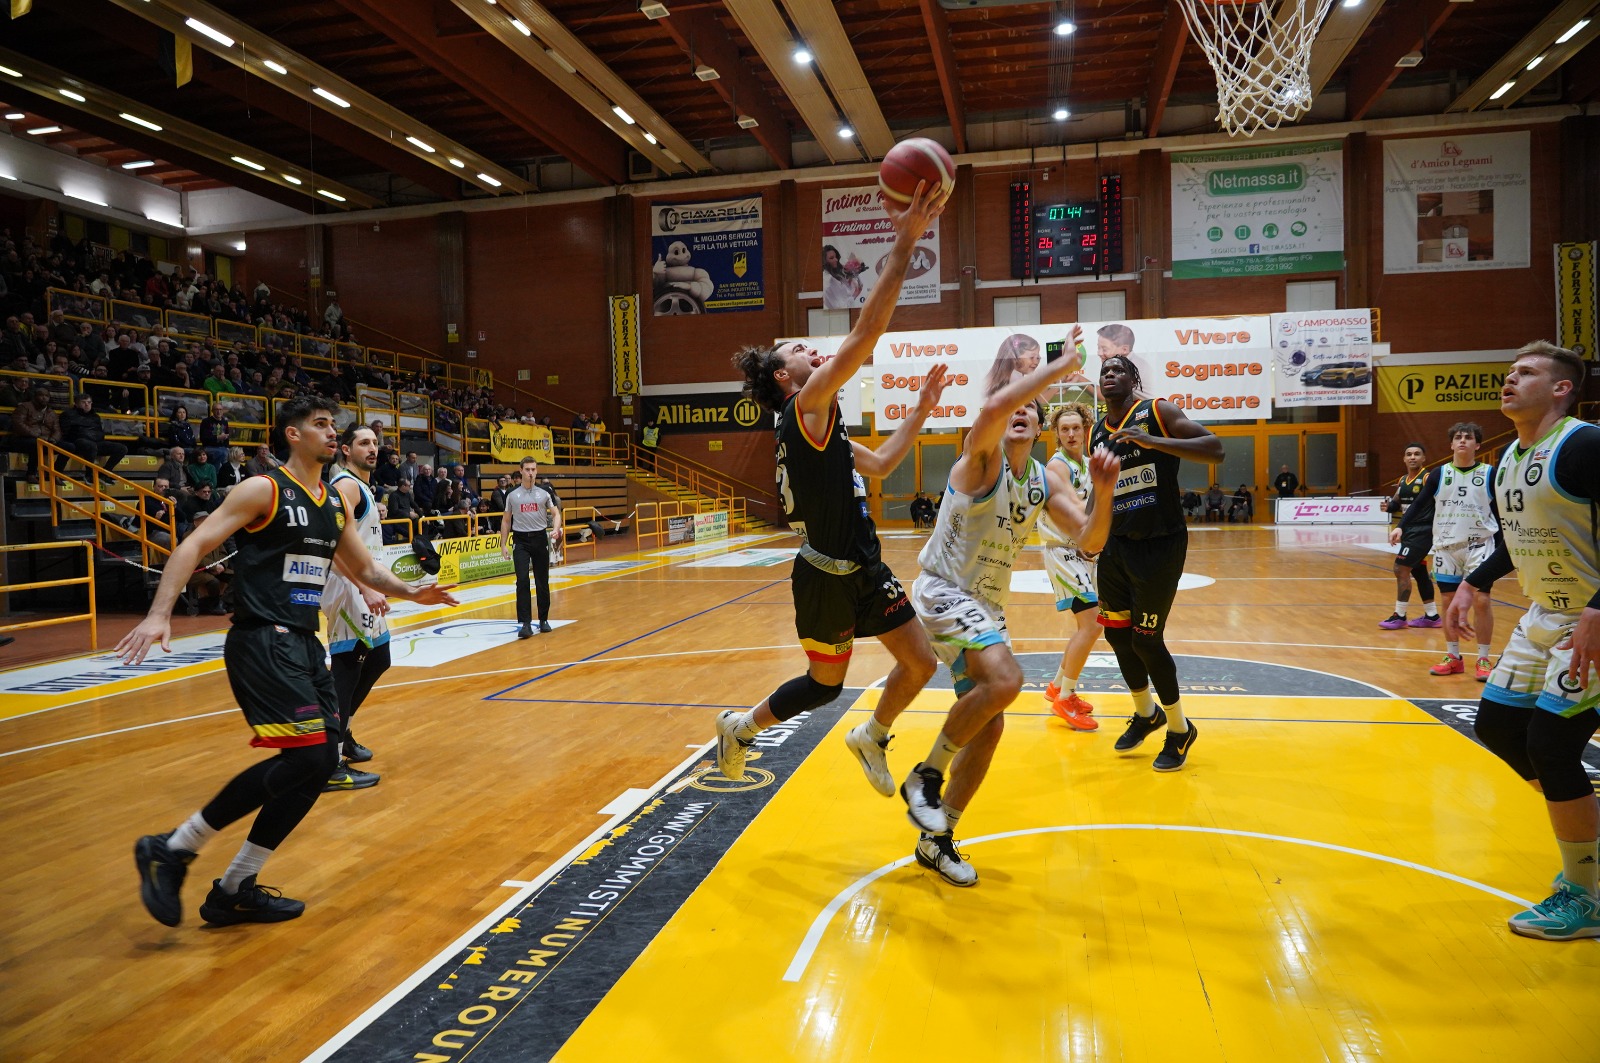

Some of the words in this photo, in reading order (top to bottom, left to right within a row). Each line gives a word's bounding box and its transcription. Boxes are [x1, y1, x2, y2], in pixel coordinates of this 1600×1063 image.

[1192, 155, 1231, 163] PARTNER
[1252, 152, 1277, 160] TUTTE
[1292, 144, 1335, 155] RISPOSTE
[1411, 158, 1450, 169] d'Amico
[1452, 155, 1493, 168] Legnami
[1213, 170, 1298, 189] Netmassa.it
[825, 193, 871, 214] Intimo
[1198, 201, 1243, 212] Esperienza
[681, 206, 759, 219] CIAVARELLA
[1206, 213, 1220, 222] per
[1224, 210, 1231, 218] la
[1234, 208, 1262, 218] vostra
[1265, 207, 1307, 218] tecnologia
[832, 221, 872, 233] L'intimo
[874, 220, 891, 230] che
[701, 234, 728, 242] MIGLIOR
[728, 232, 757, 240] SERVIZIO
[729, 240, 758, 248] VETTURA
[1038, 237, 1053, 249] 26
[1082, 234, 1097, 247] 22
[1048, 256, 1053, 268] 1
[1092, 253, 1096, 265] 1
[1572, 262, 1581, 304] FORZA
[1297, 317, 1367, 327] CAMPOBASSO
[1572, 309, 1581, 342] NERI
[622, 312, 630, 347] FORZA
[1175, 328, 1251, 346] Vivere
[890, 342, 958, 358] Vivere
[1165, 360, 1262, 381] Sognare
[1169, 392, 1260, 410] Giocare
[656, 404, 729, 424] Allianz
[1458, 486, 1467, 497] 5
[1505, 489, 1523, 513] 13
[1324, 504, 1370, 513] LOTRAS
[285, 505, 309, 527] 10
[1517, 527, 1558, 538] SINERGIE
[439, 538, 481, 556] INFANTE
[460, 560, 480, 569] EDILIZIA
[1435, 556, 1443, 568] 5
[1139, 612, 1158, 629] 13
